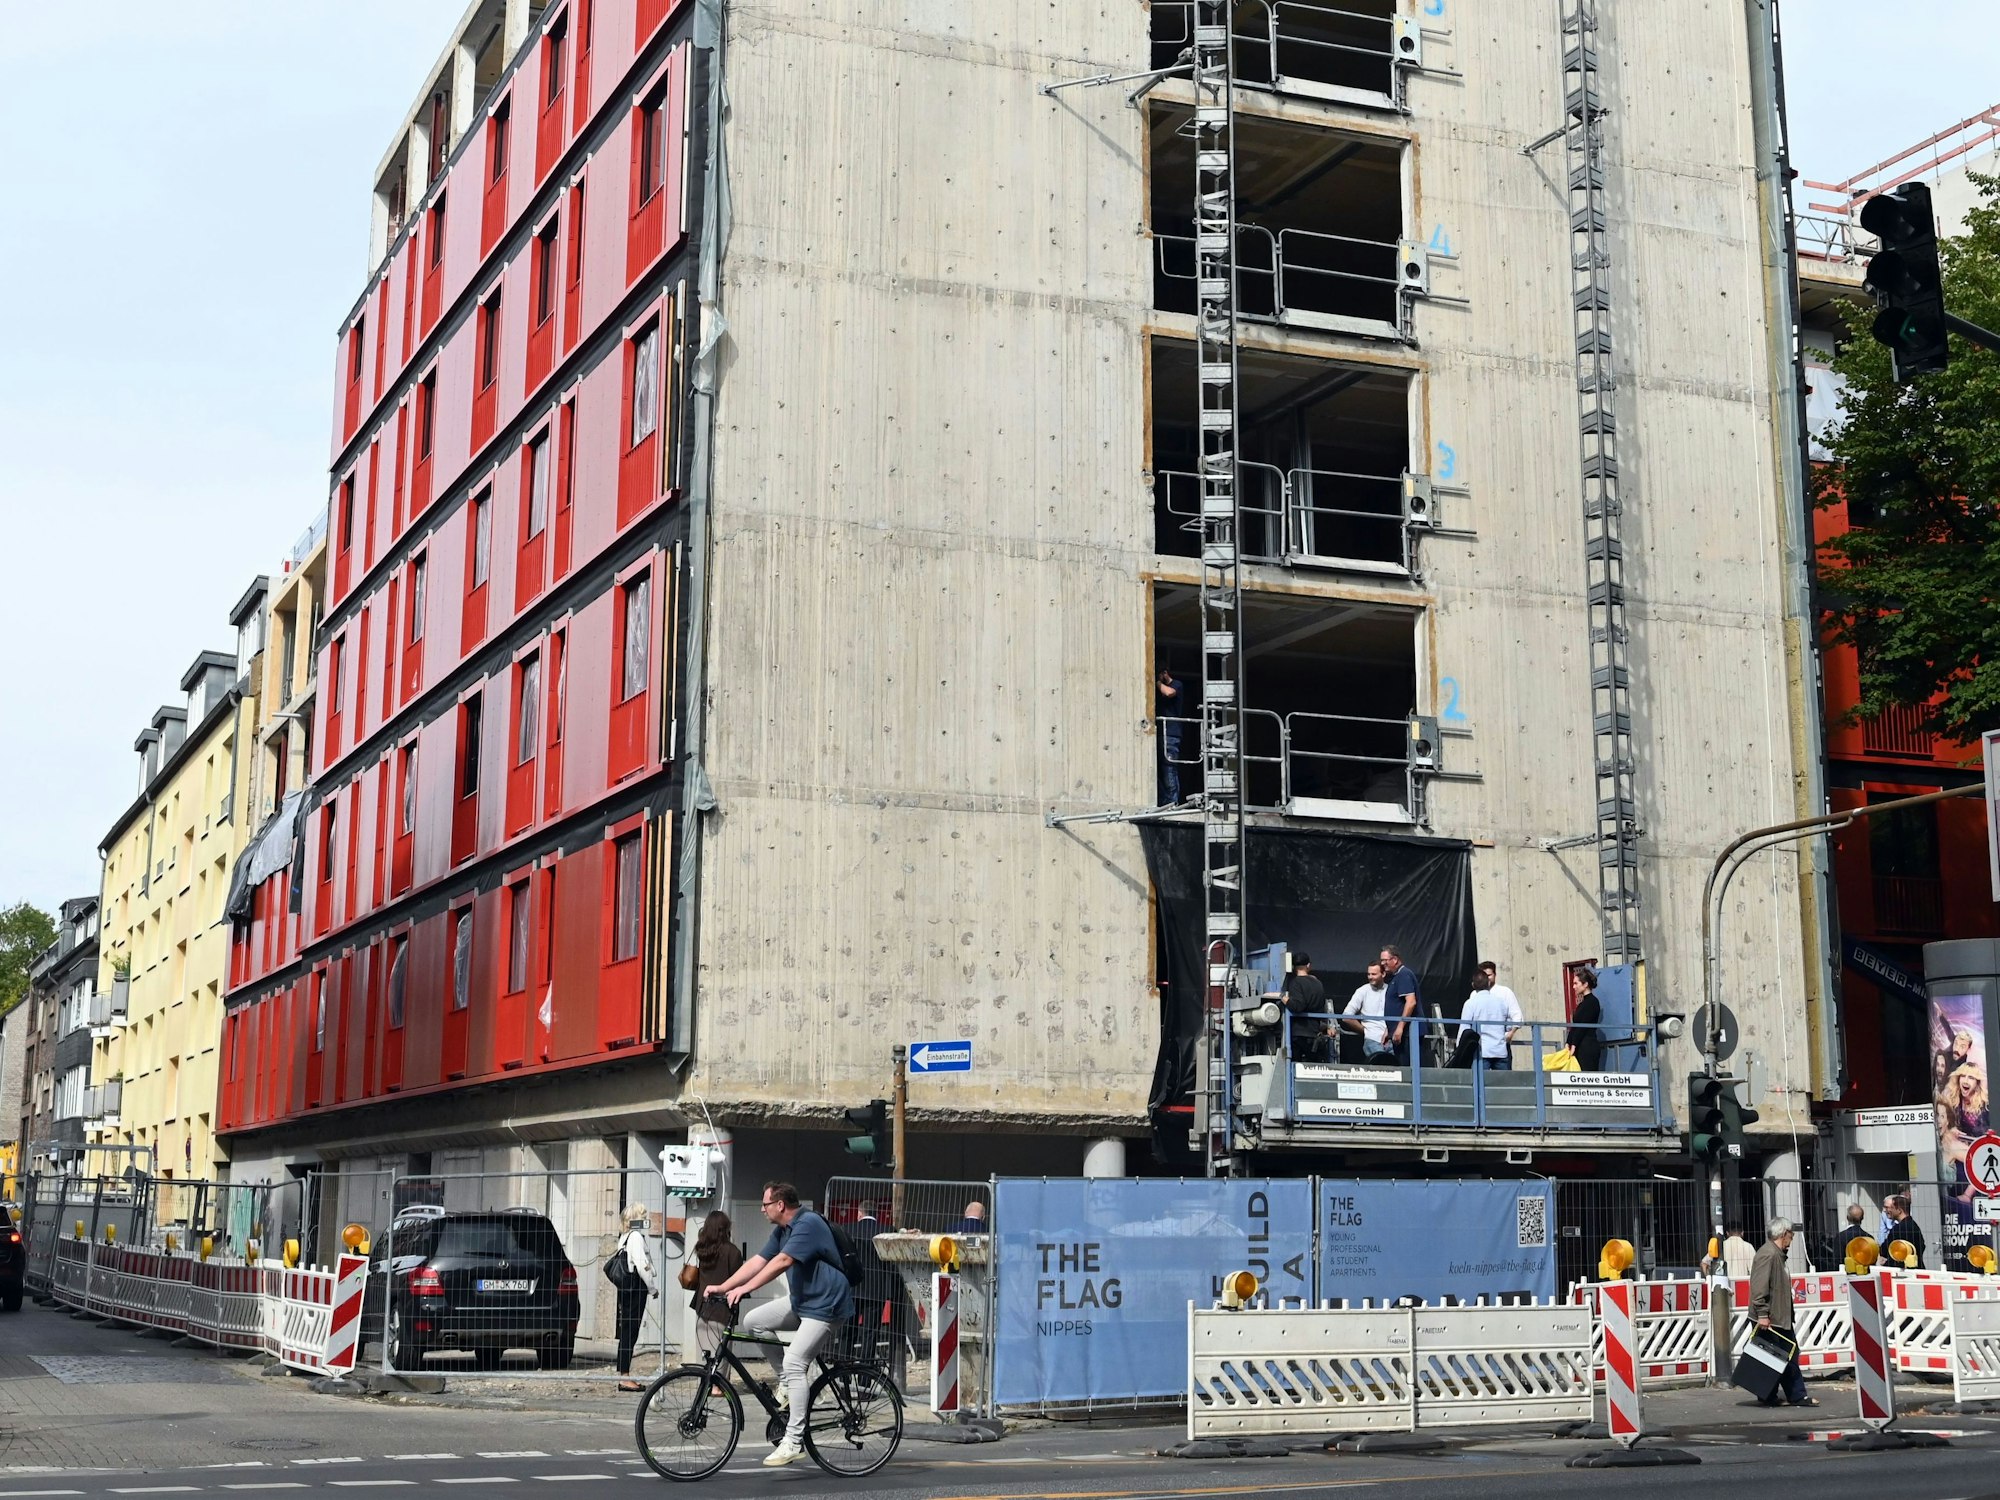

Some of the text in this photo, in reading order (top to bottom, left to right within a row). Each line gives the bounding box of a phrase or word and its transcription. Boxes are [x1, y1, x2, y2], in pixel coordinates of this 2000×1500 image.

[1429, 223, 1450, 257] 4
[1438, 440, 1456, 479] 3
[1440, 676, 1466, 720] 2
[1853, 947, 1927, 999] BEYER-MI
[926, 1052, 968, 1061] Einbahnstraße
[1569, 1075, 1631, 1084] Grewe GmbH
[1558, 1089, 1605, 1098] Vermietung
[1319, 1106, 1384, 1115] Grewe GmbH
[1894, 1113, 1915, 1121] 0228
[1918, 1112, 1929, 1120] 98
[1330, 1197, 1354, 1210] THE
[1330, 1212, 1362, 1226] FLAG
[1944, 1213, 1959, 1225] DIE
[1330, 1233, 1356, 1241] YOUNG
[1330, 1244, 1382, 1253] PROFESSIONAL
[1036, 1243, 1100, 1273] THE
[1330, 1256, 1368, 1265] & STUDENT
[1330, 1268, 1377, 1277] APARTMENTS
[1037, 1278, 1122, 1310] FLAG
[1036, 1319, 1093, 1336] NIPPES
